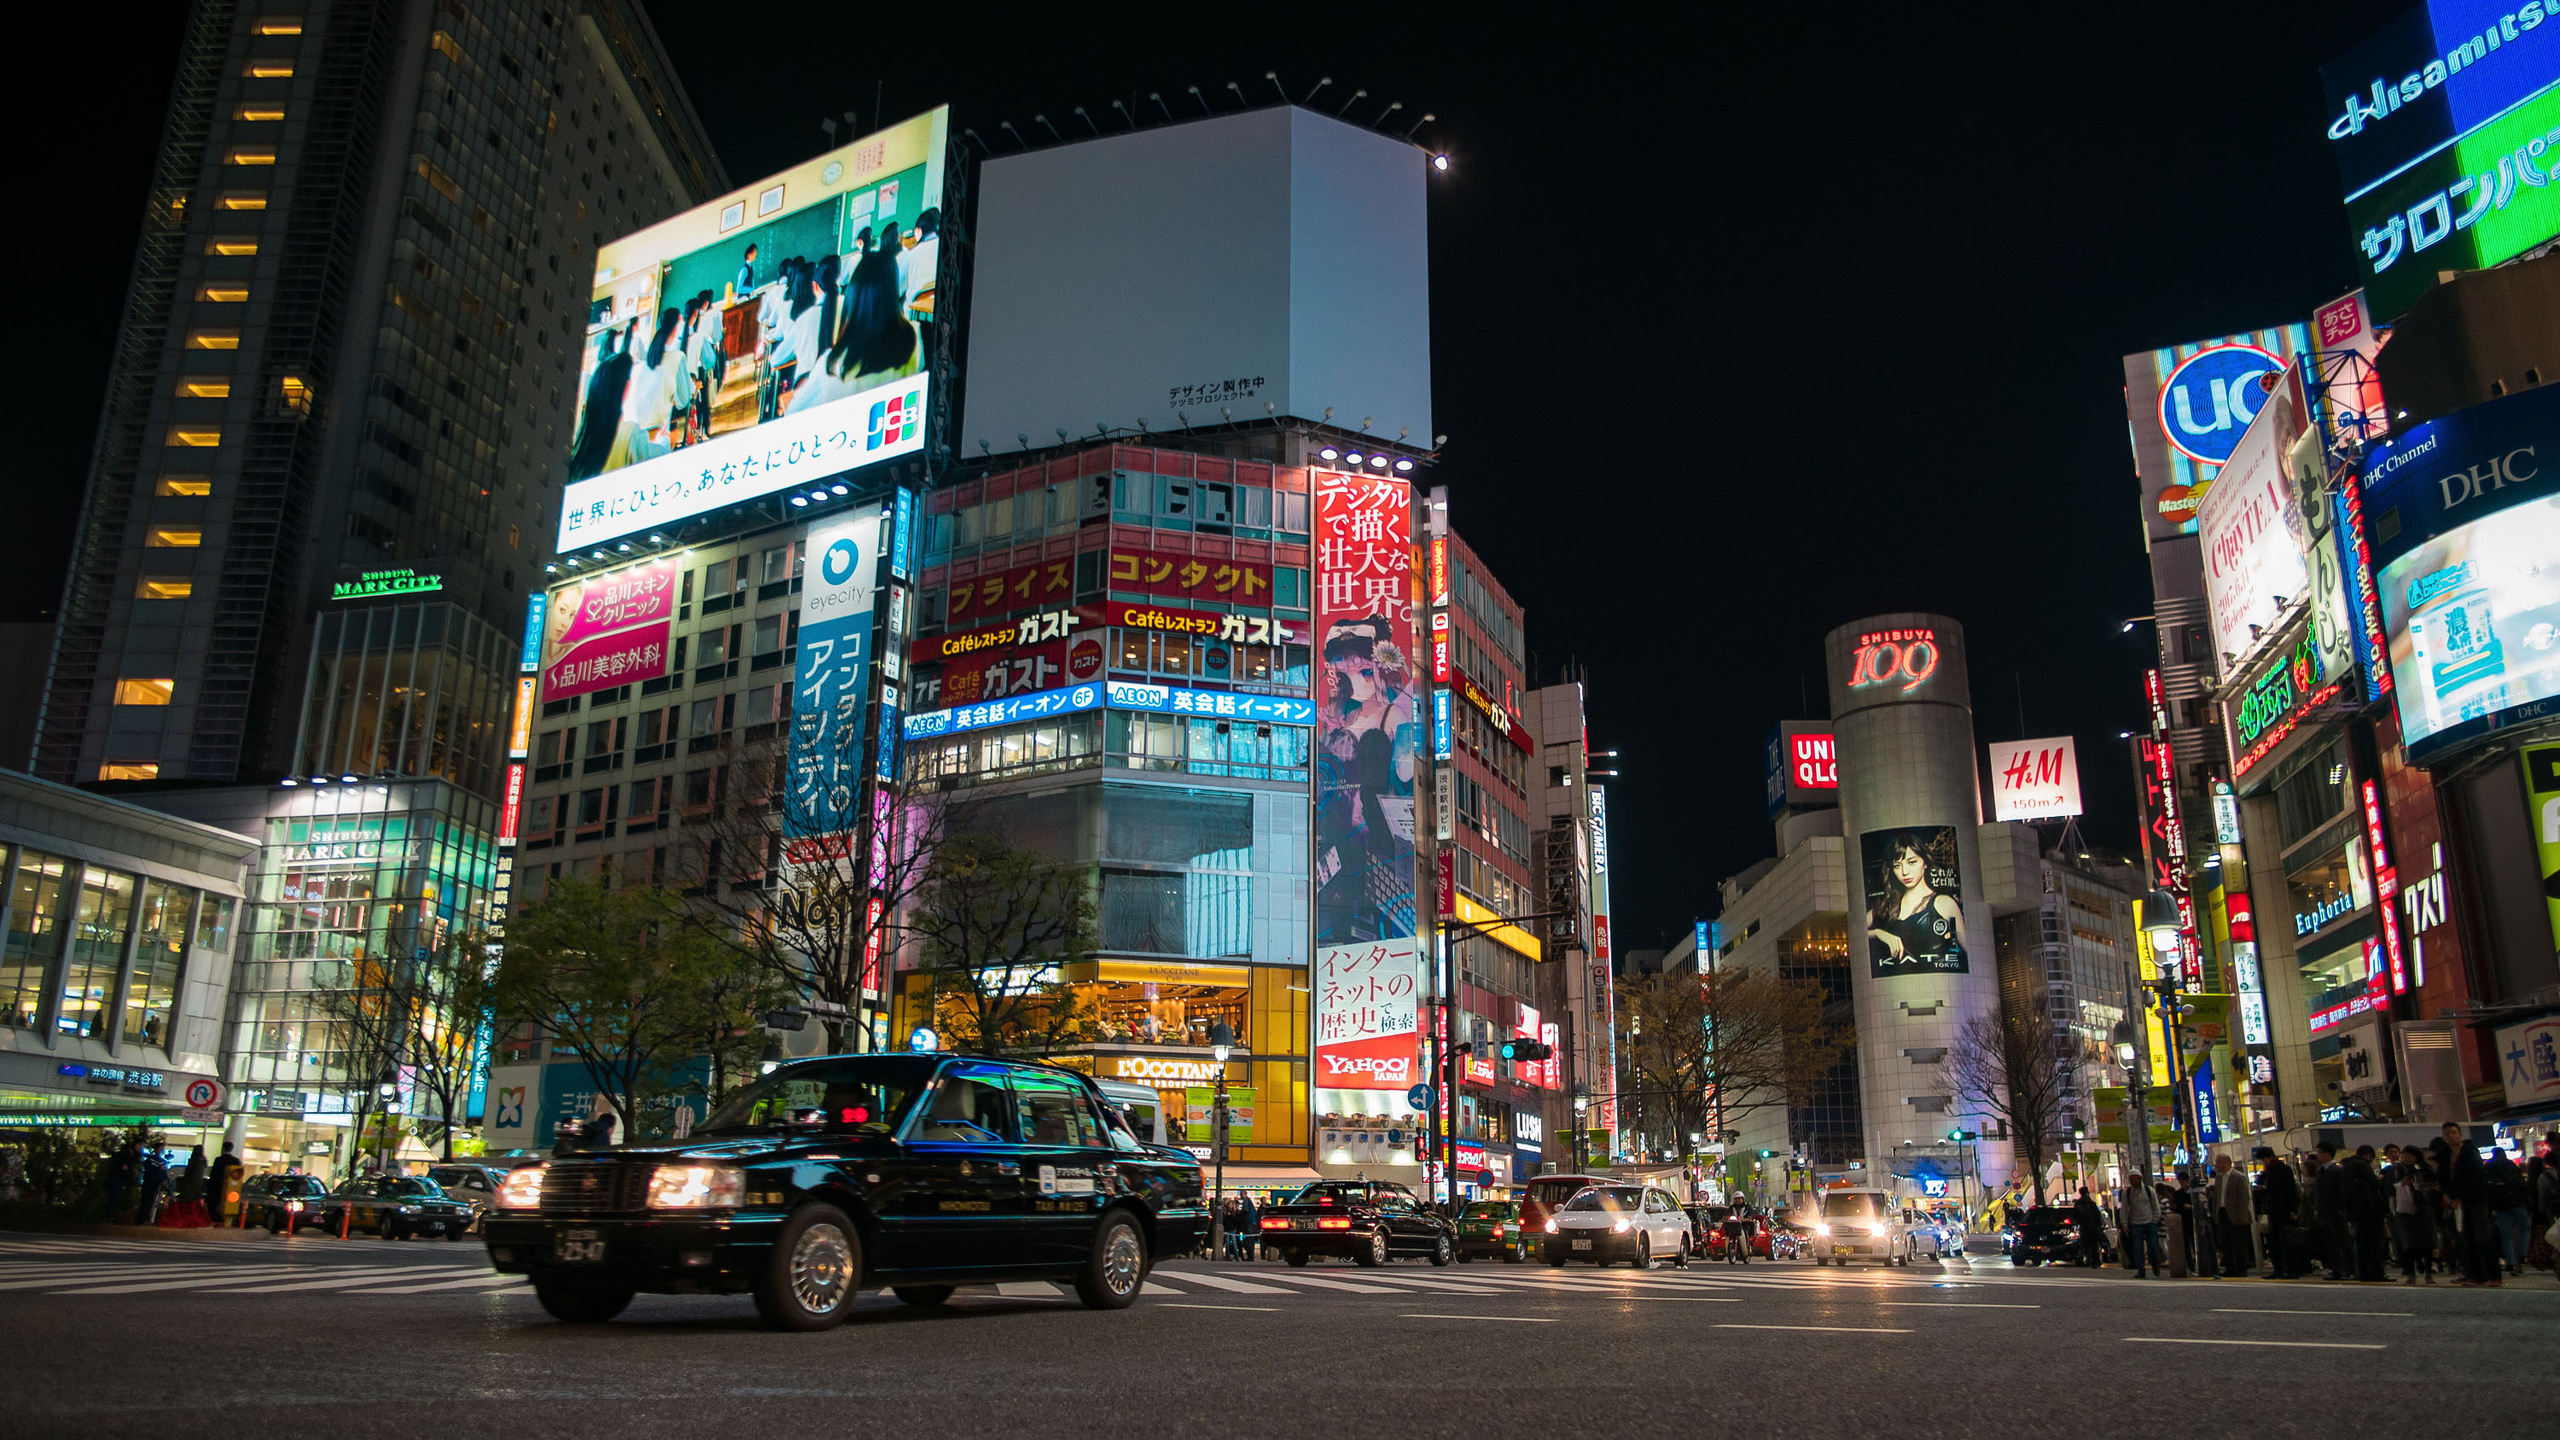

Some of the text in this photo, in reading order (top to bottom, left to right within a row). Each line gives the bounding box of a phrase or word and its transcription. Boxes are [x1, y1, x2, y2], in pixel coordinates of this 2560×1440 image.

[1170, 376, 1265, 399] デザイン製作中
[2363, 434, 2438, 491] DHC Channel
[2439, 445, 2539, 511] DHC
[1317, 476, 1411, 513] デジタル
[1319, 537, 1409, 577] 壮大な
[334, 574, 442, 596] MARK CITY
[362, 568, 415, 581] SHIBUYA
[604, 573, 670, 606] 品川スキン
[950, 561, 1070, 615] プライス
[1112, 554, 1267, 596] コンタクト
[602, 596, 661, 627] クリニック
[810, 586, 865, 612] eyecity
[1018, 609, 1080, 646] ガスト
[1220, 614, 1295, 647] ガスト
[1860, 630, 1935, 645] SHIBUYA
[560, 642, 661, 688] 品川美容外科
[983, 655, 1059, 700] ガスト
[1074, 656, 1099, 669] ガスト
[1847, 640, 1939, 691] 109
[956, 691, 1092, 729] 英会話イーオン 6F
[1114, 688, 1161, 705] AEON
[1174, 691, 1312, 720] 英会話イーオン
[2517, 702, 2548, 718] DHC
[2003, 747, 2063, 790] H&M
[1438, 775, 1449, 834] 渋谷駅前ビル
[1590, 791, 1602, 814] BIC
[2013, 797, 2050, 810] 150m
[280, 844, 348, 861] MARK
[311, 830, 380, 843] SHIBUYA
[2294, 891, 2353, 935] Euphoria
[1149, 966, 1200, 977] L'OCCITANE
[1319, 945, 1414, 978] インター
[1319, 973, 1413, 1009] ネットの
[1319, 1007, 1377, 1041] 歴史
[1380, 1013, 1414, 1033] 検索
[91, 1067, 163, 1087] 井の頭線 渋谷駅
[1322, 1055, 1410, 1074] YAHOO!
[1374, 1071, 1408, 1081] JAPAN
[1516, 1112, 1543, 1143] LUSH
[2198, 1091, 2212, 1134] みずほ銀行
